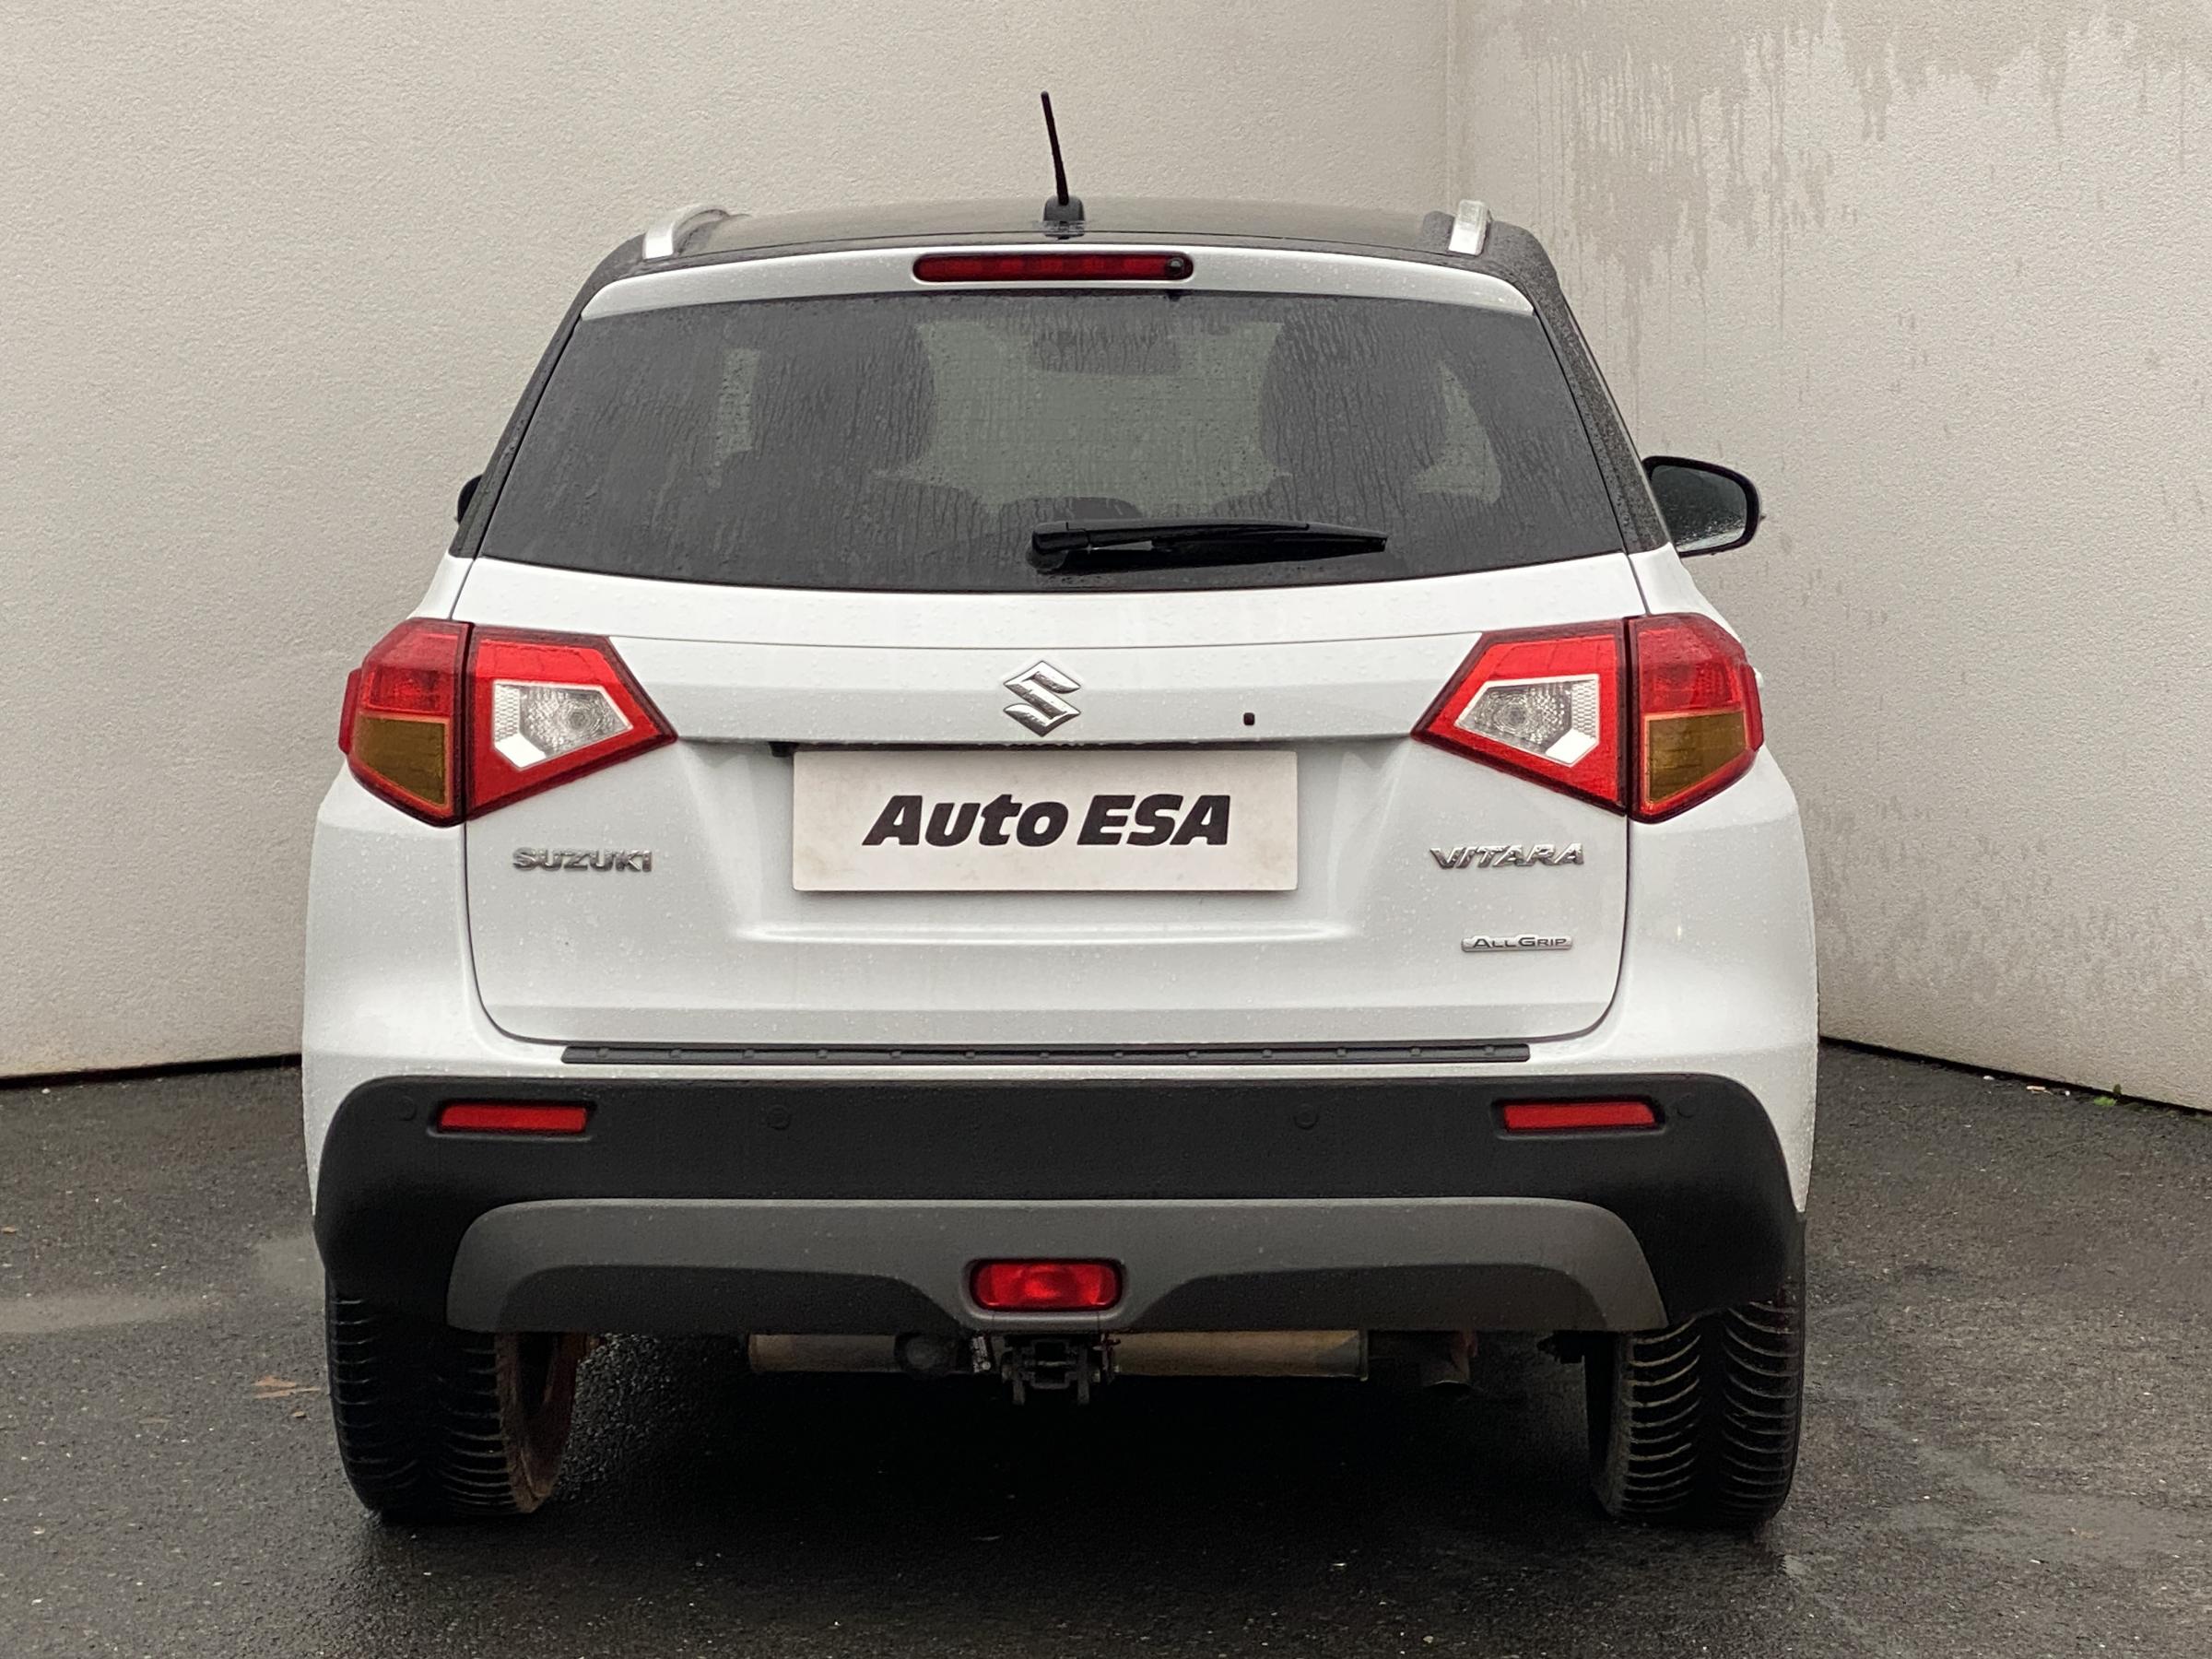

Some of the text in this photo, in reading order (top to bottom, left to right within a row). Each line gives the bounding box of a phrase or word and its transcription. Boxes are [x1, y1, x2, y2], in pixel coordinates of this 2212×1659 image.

[861, 793, 1231, 847] Auto ESA
[512, 846, 653, 872] SUZUKI
[1430, 842, 1584, 869] VITARA
